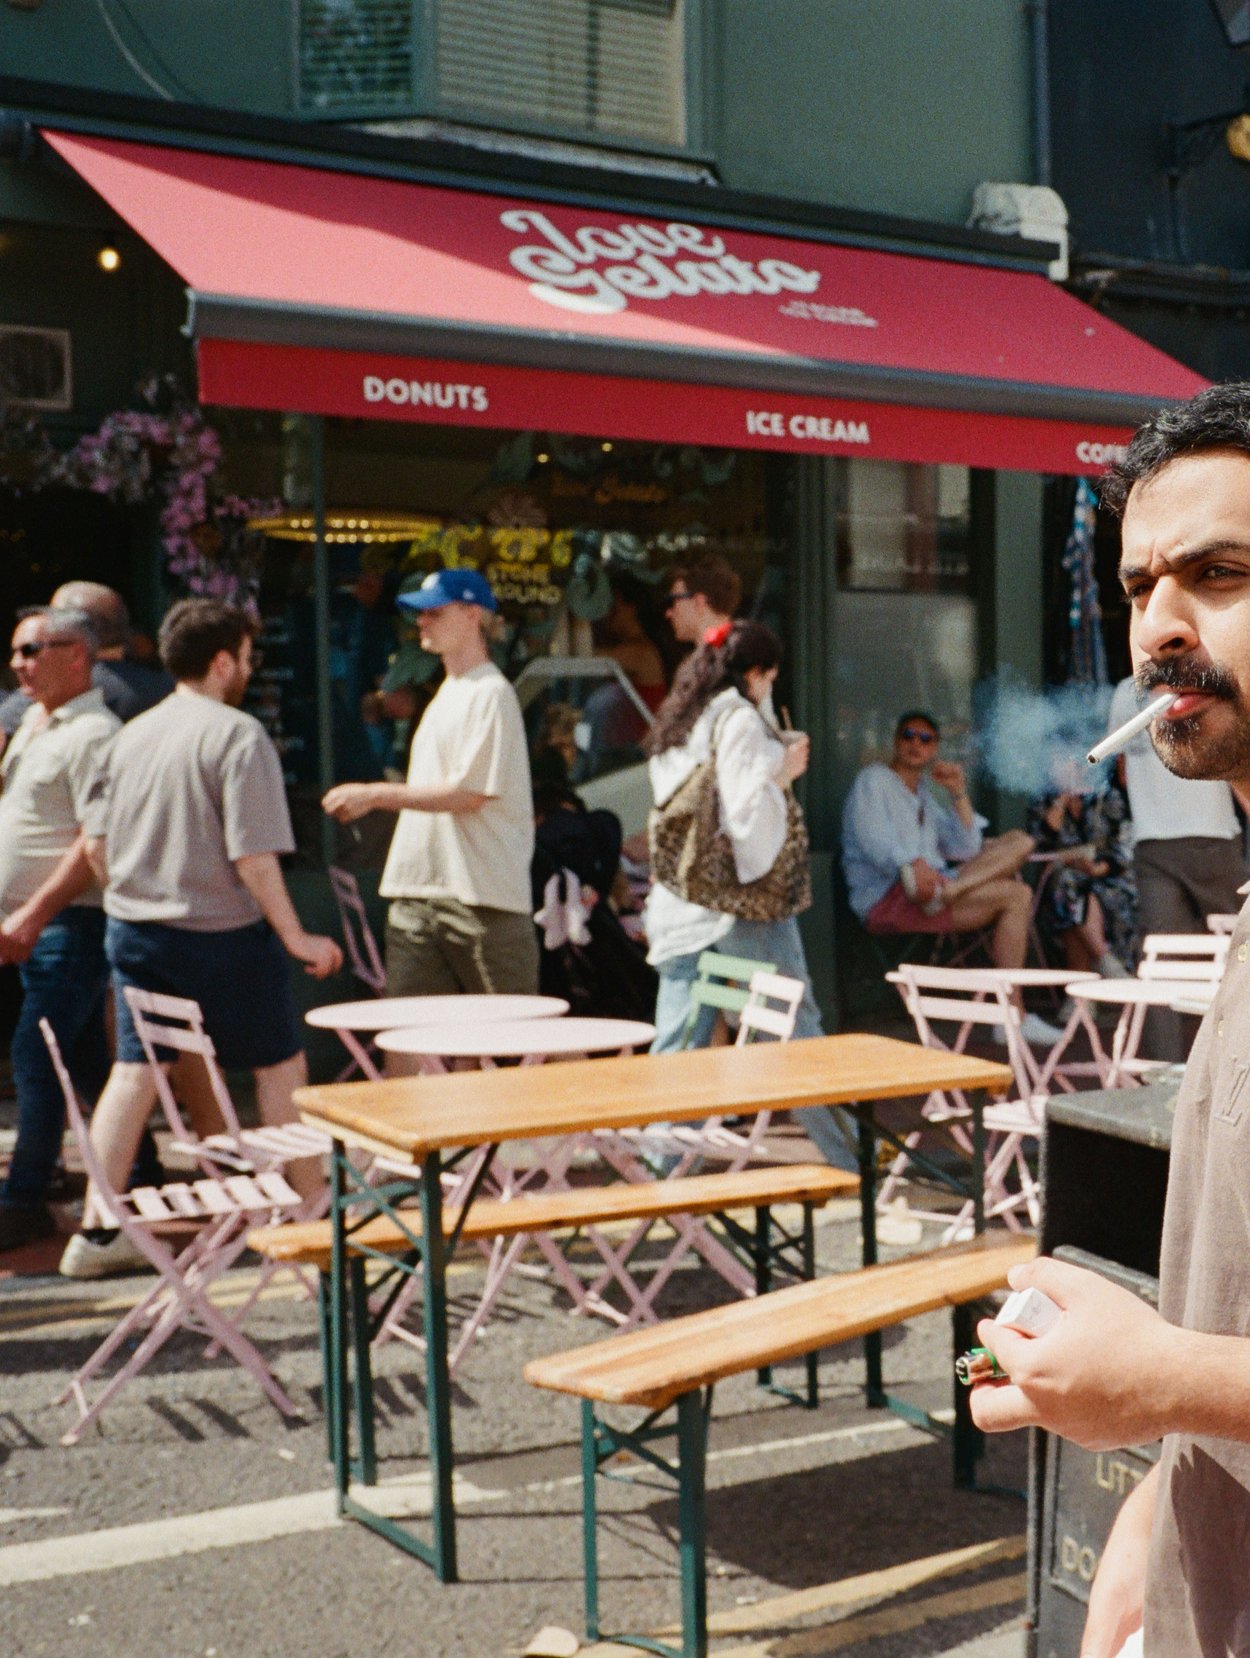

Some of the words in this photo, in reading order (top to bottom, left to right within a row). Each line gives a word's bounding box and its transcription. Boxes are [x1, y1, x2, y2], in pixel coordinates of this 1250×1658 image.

[500, 210, 726, 264] Love
[509, 245, 822, 315] Gelato
[363, 375, 489, 412] DONUTS
[745, 410, 785, 437] ICE
[789, 415, 870, 443] CREAM
